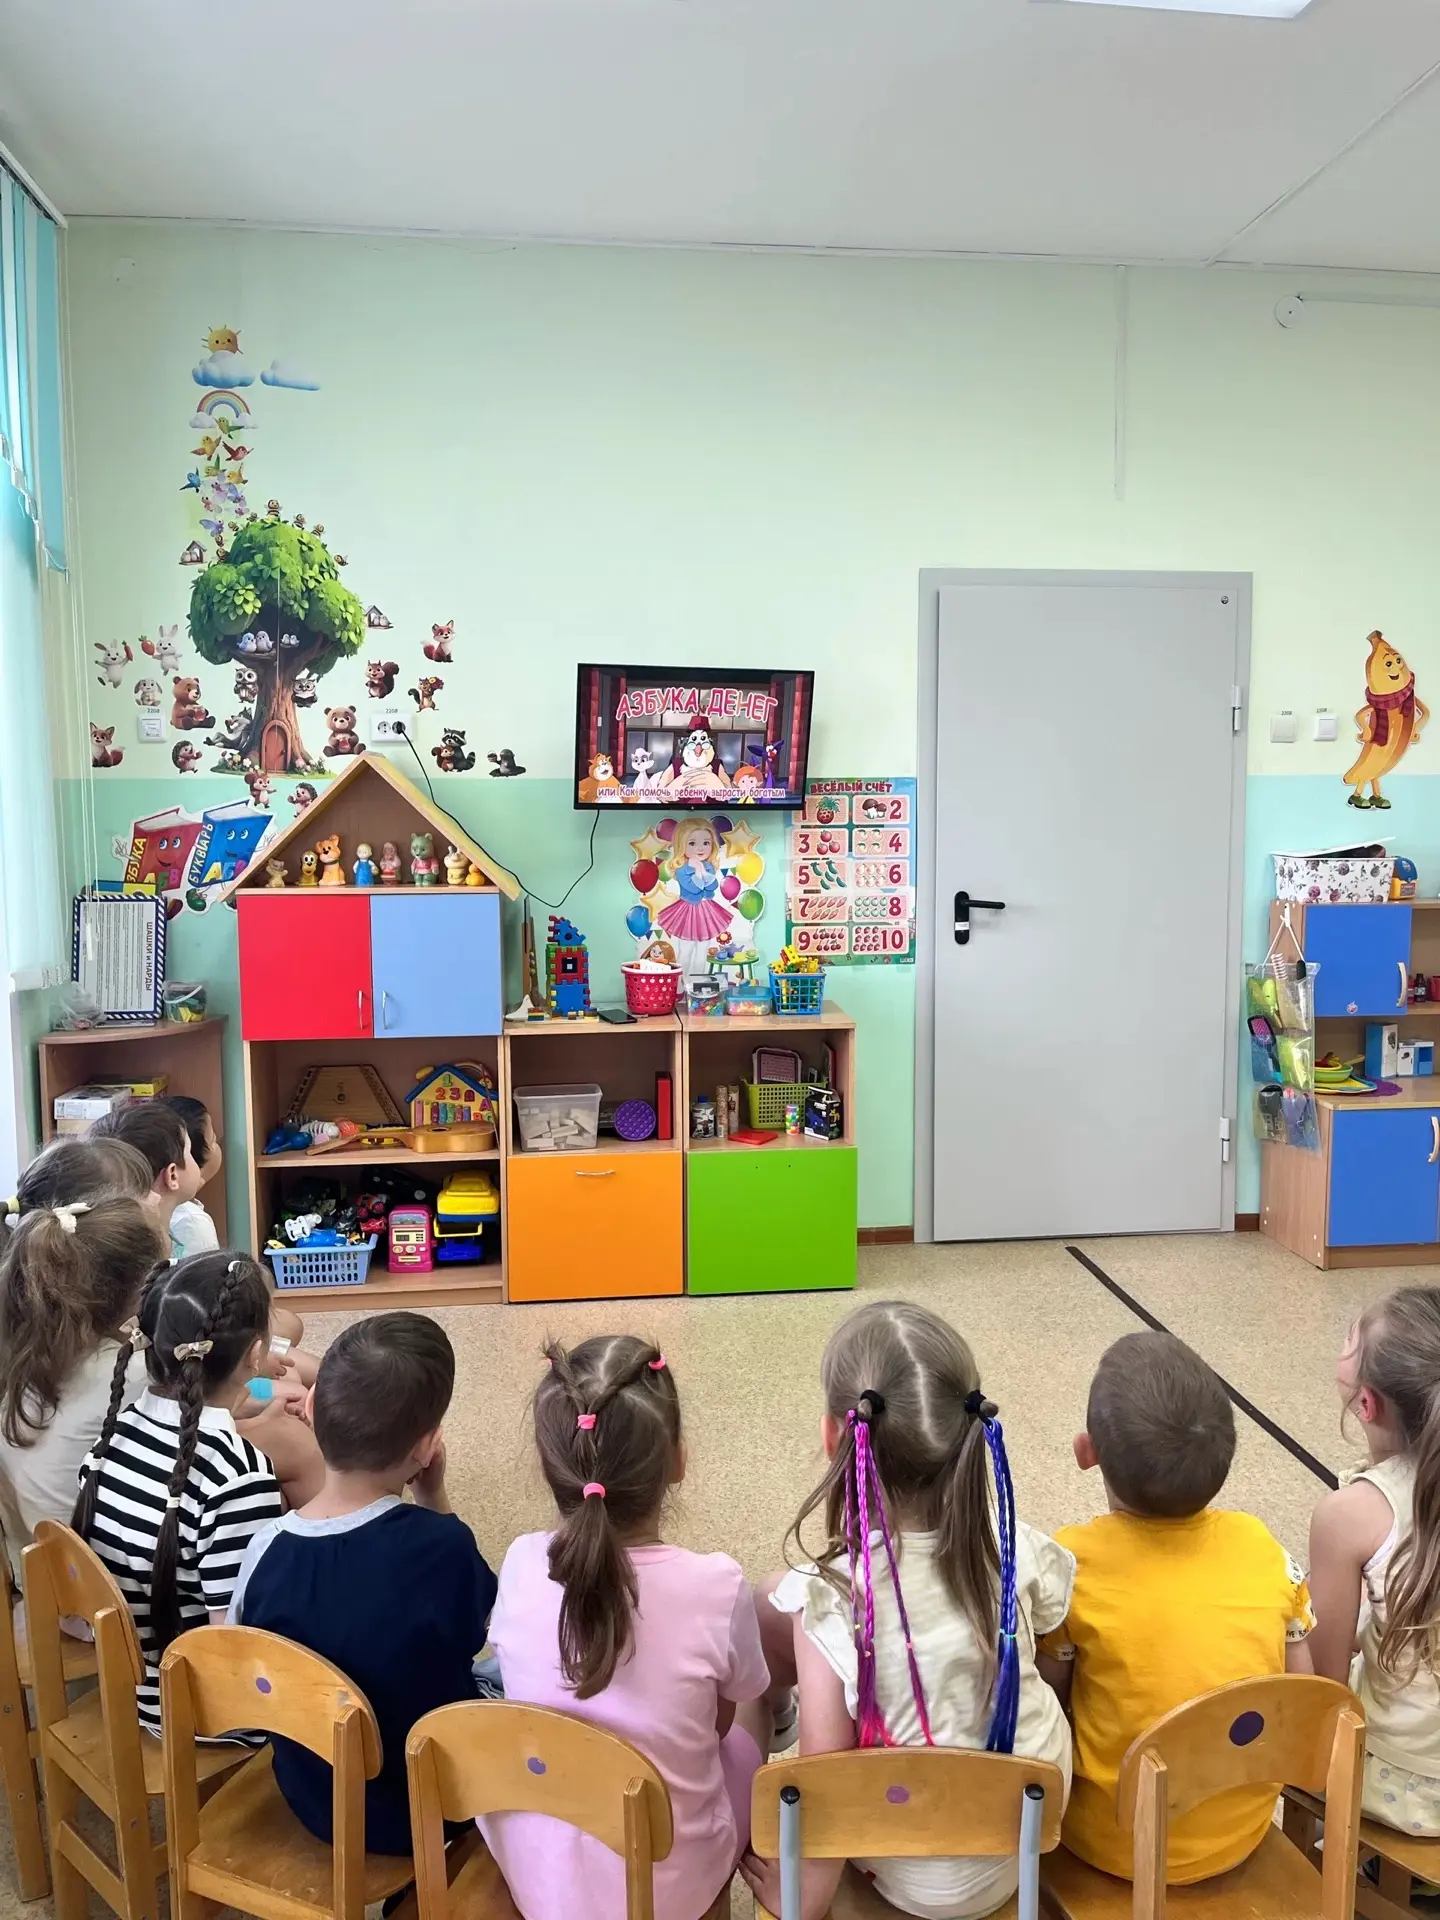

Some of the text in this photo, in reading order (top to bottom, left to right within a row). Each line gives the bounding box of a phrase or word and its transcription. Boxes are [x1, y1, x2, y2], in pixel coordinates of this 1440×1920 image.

[615, 687, 778, 722] АЗБУКА ДЕНЕГ
[597, 785, 786, 799] или Как помочь ребенку вырасти богатым
[810, 779, 893, 793] ВЕСЁЛЫЙ СЧЁТ
[889, 800, 902, 820] 2
[188, 823, 214, 883] БУКВАРЬ
[798, 832, 903, 853] 3 4
[126, 836, 148, 882] ЗБУКА
[798, 864, 902, 885] 5 6
[798, 896, 901, 918] 7 8
[798, 929, 904, 950] 9 10
[145, 962, 153, 991] НАРДЫ
[435, 1087, 461, 1100] 2 3
